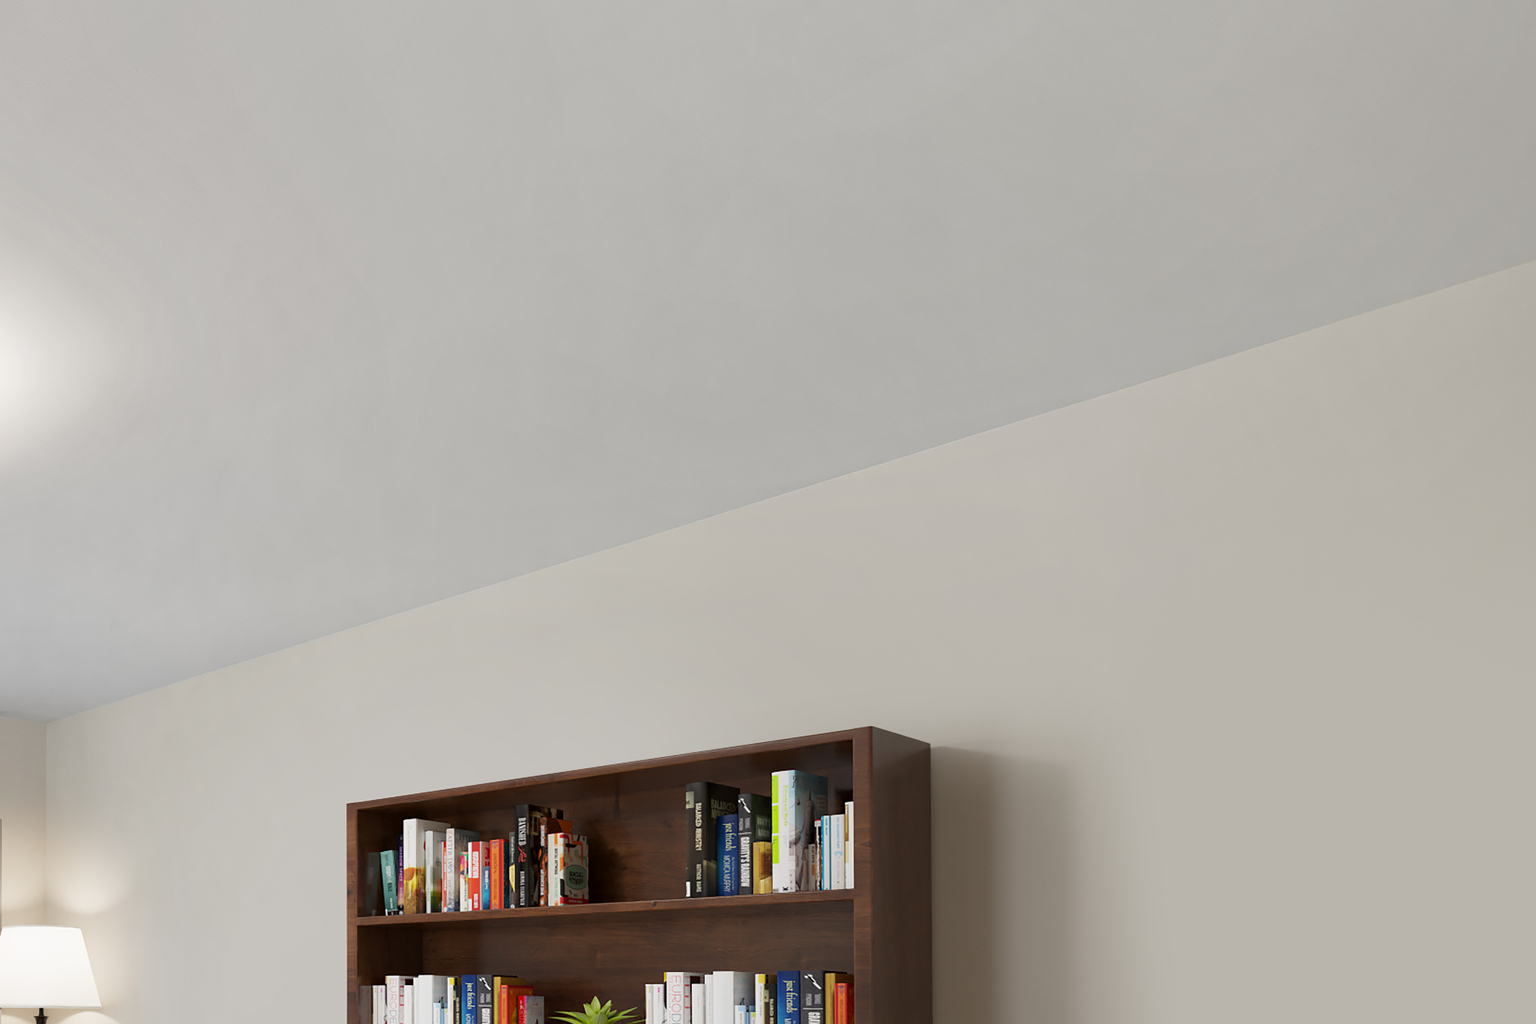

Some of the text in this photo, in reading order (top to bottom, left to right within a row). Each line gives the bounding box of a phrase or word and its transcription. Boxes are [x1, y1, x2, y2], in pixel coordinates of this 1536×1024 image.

[518, 818, 526, 845] BANISHED
[722, 822, 736, 852] just friends
[741, 836, 750, 887] GRAVITY'S RAINBOW
[465, 982, 475, 1010] just friends
[783, 980, 798, 1013] just friends
